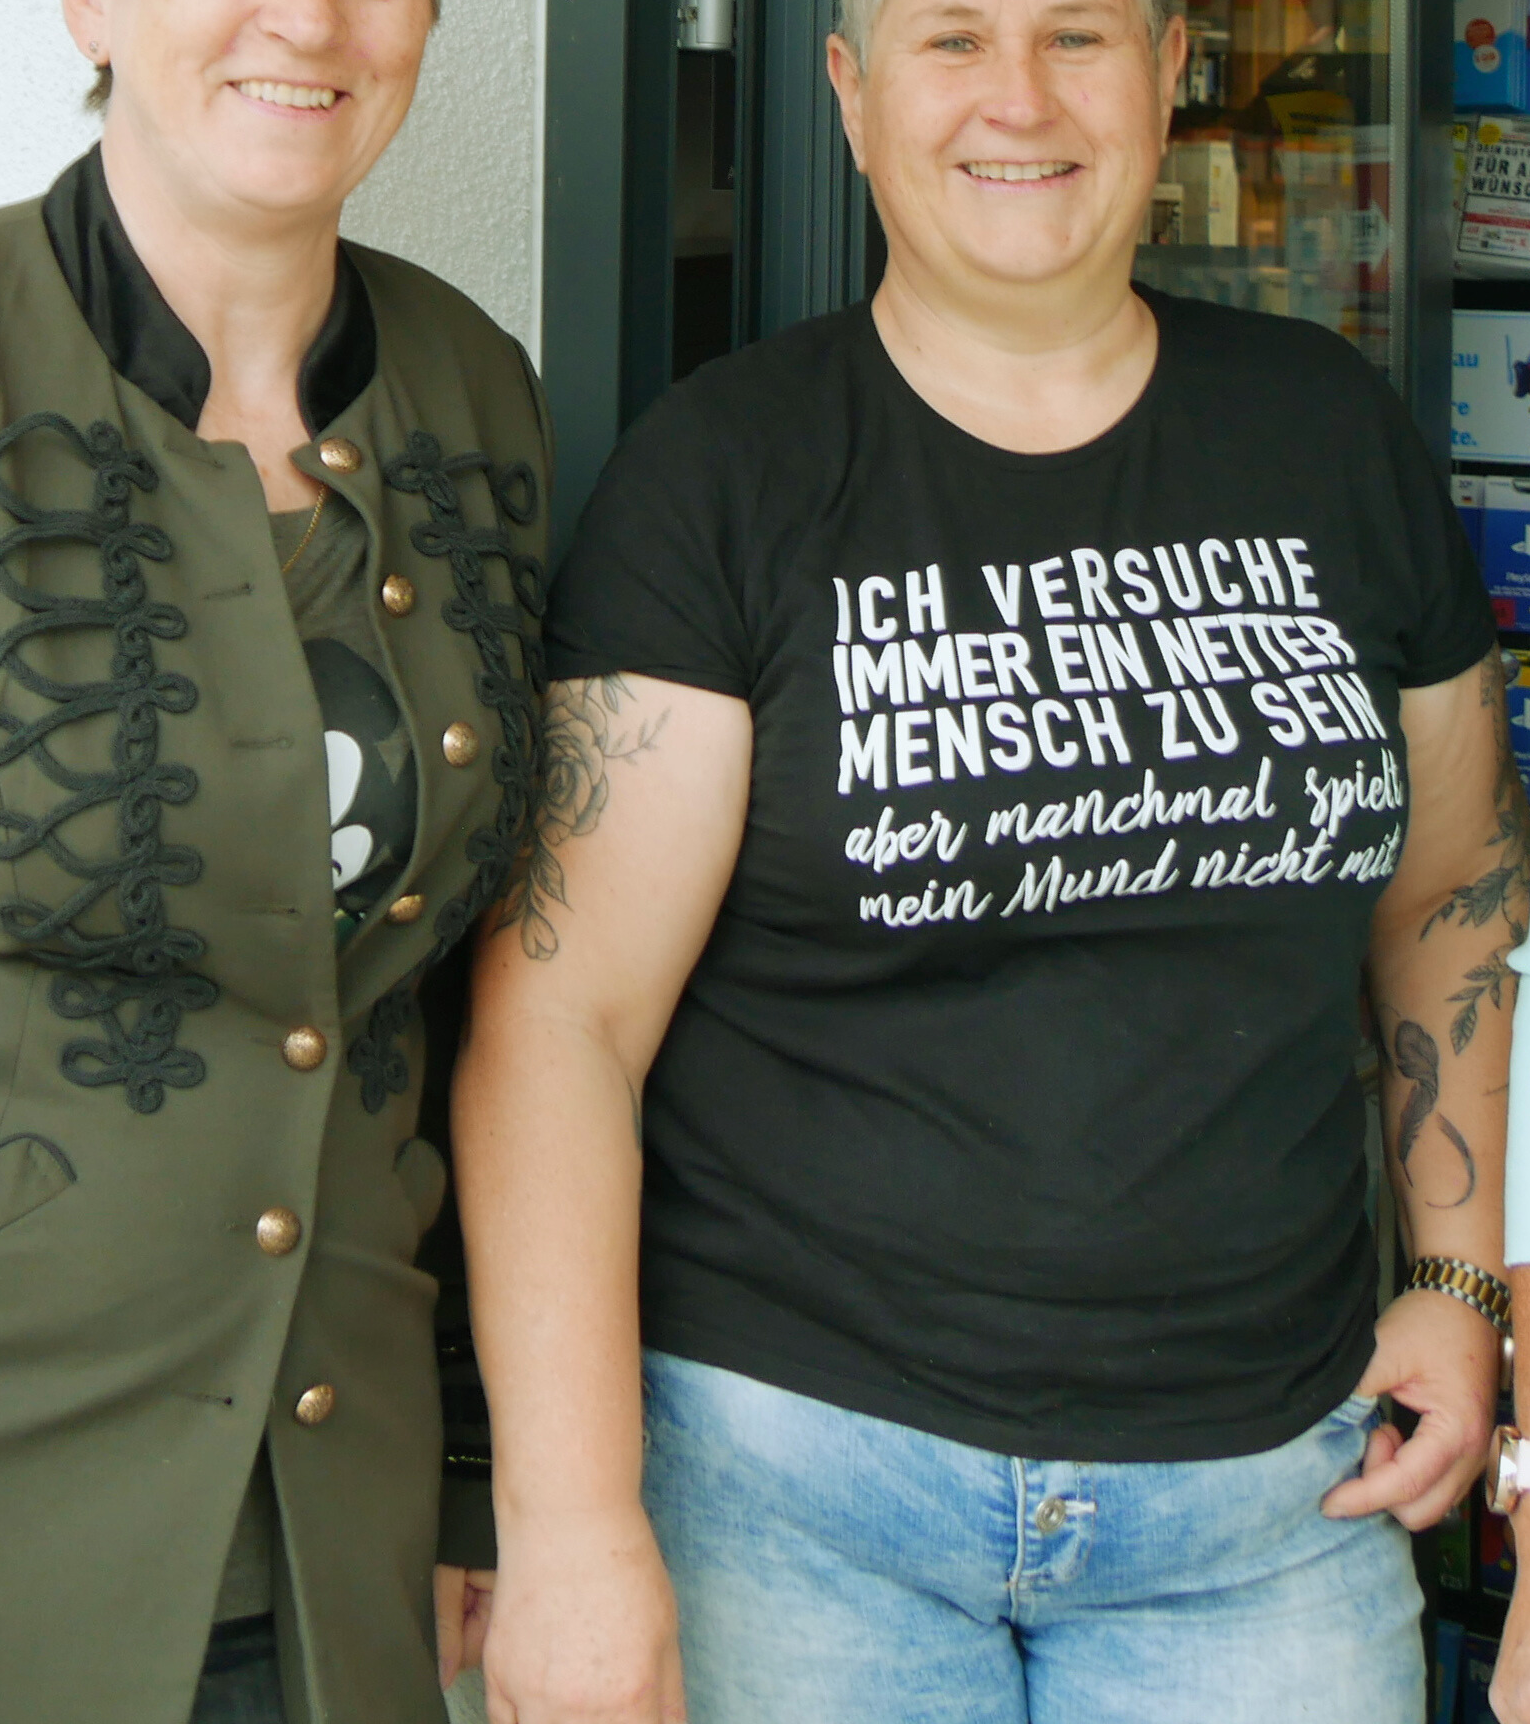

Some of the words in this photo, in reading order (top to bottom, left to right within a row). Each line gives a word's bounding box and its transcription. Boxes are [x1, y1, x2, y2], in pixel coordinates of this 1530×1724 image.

[1453, 351, 1479, 368] au
[833, 563, 948, 644] ICH
[981, 537, 1320, 627] VERSUCHE
[833, 632, 1040, 714] IMMER
[1044, 622, 1151, 695] EIN
[1149, 611, 1357, 687] NETTER
[837, 699, 1132, 794] MENSCH
[1143, 687, 1240, 760] ZU
[1251, 672, 1389, 749] SEIN
[844, 805, 968, 873] aber
[985, 756, 1277, 846] manchmal
[1304, 747, 1403, 839] spielt
[859, 878, 994, 928] mein
[1000, 838, 1180, 918] Mund
[1190, 826, 1335, 891] nicht
